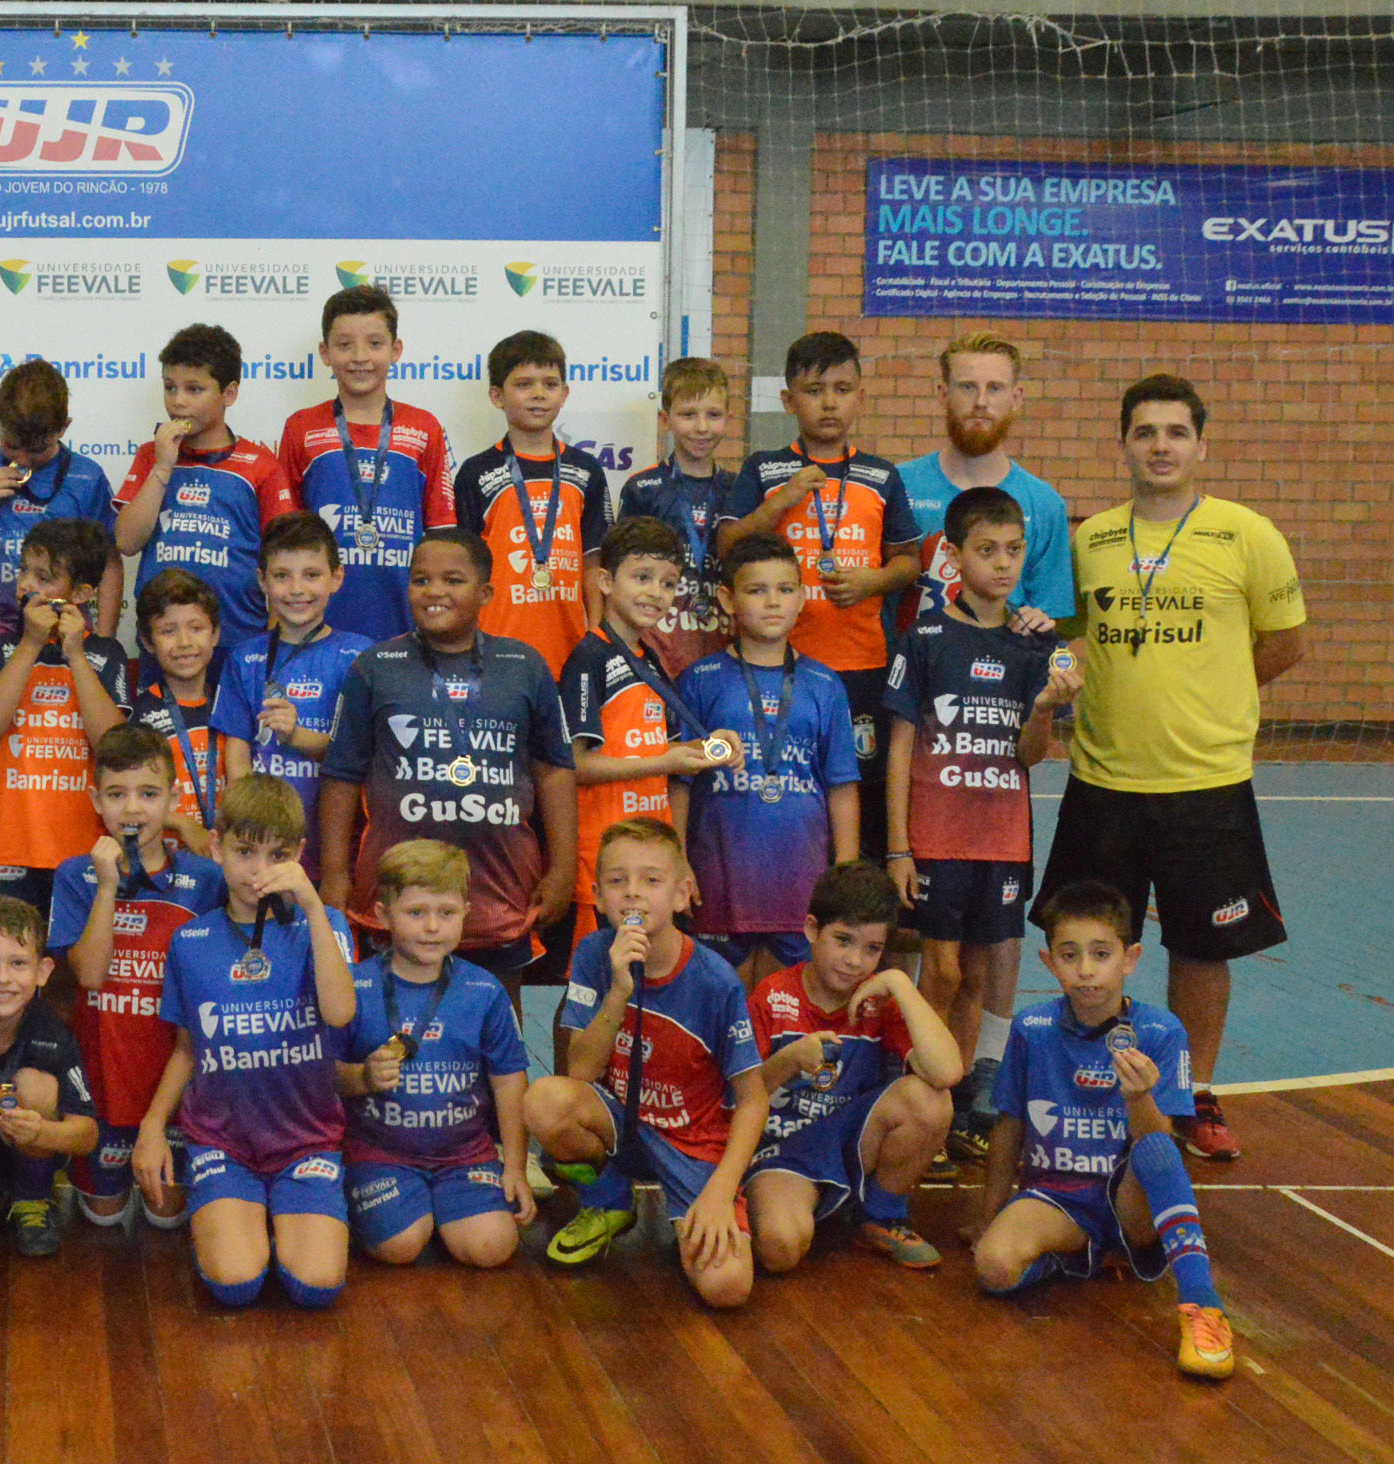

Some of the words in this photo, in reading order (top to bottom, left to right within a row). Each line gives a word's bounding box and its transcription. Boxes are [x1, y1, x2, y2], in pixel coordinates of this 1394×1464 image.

[5, 181, 50, 194] JOVEM
[56, 181, 74, 194] DO
[76, 179, 128, 194] RINCÃO
[139, 181, 168, 194] 1978
[880, 175, 944, 200] LEVE
[951, 176, 973, 201] A
[979, 176, 1036, 202] SUA
[1044, 177, 1176, 205] EMPRESA
[879, 204, 963, 234] MAIS
[973, 205, 1089, 237] LONGE.
[1202, 217, 1391, 243] EXATUS
[877, 239, 940, 265] FALE
[947, 241, 1016, 267] COM
[1023, 242, 1045, 268] A
[1052, 243, 1162, 270] EXATUS.
[1269, 243, 1323, 255] serviços
[37, 263, 141, 273] UNIVERSIDADE
[205, 263, 310, 273] UNIVERSIDADE
[374, 264, 478, 274] UNIVERSIDADE
[542, 266, 646, 276] UNIVERSIDADE
[37, 275, 141, 294] FEEVALE
[205, 275, 310, 294] FEEVALE
[542, 278, 646, 297] FEEVALE
[387, 354, 481, 380] anrisul
[171, 518, 231, 540] FEEVALE
[1089, 526, 1128, 542] chipbyte
[155, 540, 229, 569] Banrisul
[338, 541, 413, 567] anrisul
[973, 663, 1002, 678] UJR
[423, 728, 516, 753] FEVALE
[25, 745, 89, 760] FEEVALE
[5, 769, 88, 792] Banrisul
[417, 757, 514, 785] Barisul
[939, 765, 1021, 790] GuSch
[400, 792, 520, 825] GuSch
[1214, 899, 1248, 923] UJR
[223, 1006, 316, 1035] FEEVALE
[221, 1034, 323, 1070] Banrisul
[1076, 1071, 1116, 1086] UJR
[385, 1095, 479, 1129] Banrisul
